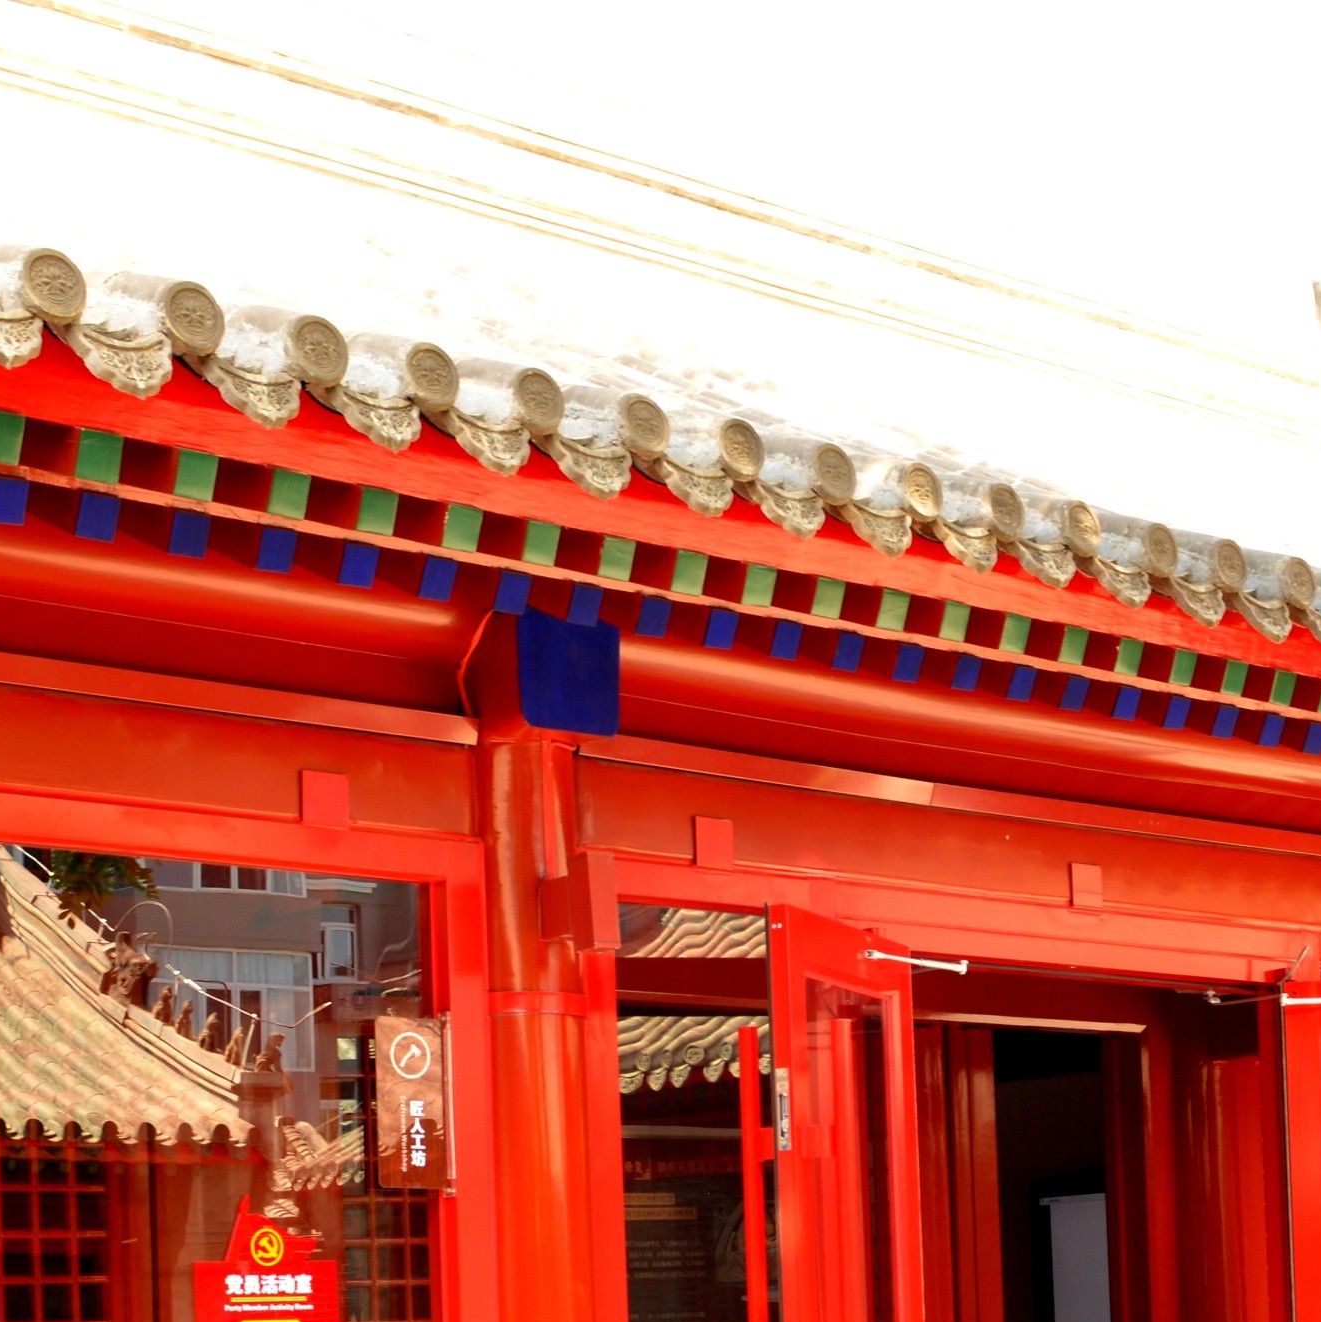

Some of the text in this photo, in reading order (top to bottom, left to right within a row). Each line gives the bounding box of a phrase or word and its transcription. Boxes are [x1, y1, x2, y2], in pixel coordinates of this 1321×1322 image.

[409, 1100, 426, 1167] 匠人工坊
[224, 1273, 313, 1295] 党员活动室
[224, 1304, 242, 1312] Party
[269, 1304, 294, 1312] Activity
